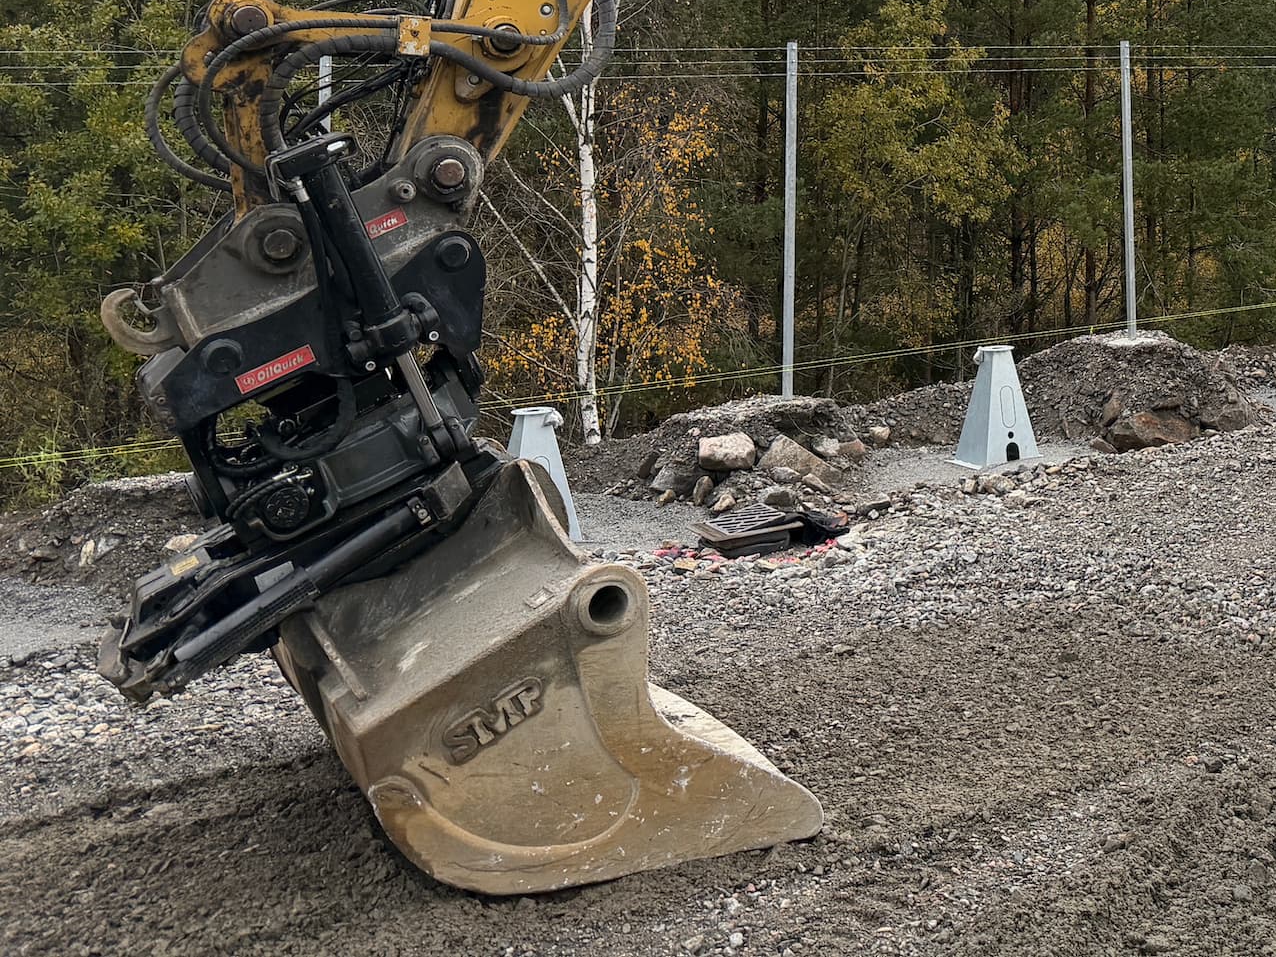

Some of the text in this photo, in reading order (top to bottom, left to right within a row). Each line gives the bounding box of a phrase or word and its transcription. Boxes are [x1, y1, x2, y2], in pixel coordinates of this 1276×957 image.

[366, 216, 398, 235] Quick
[257, 354, 304, 382] OilQuick
[443, 678, 541, 763] SMP
